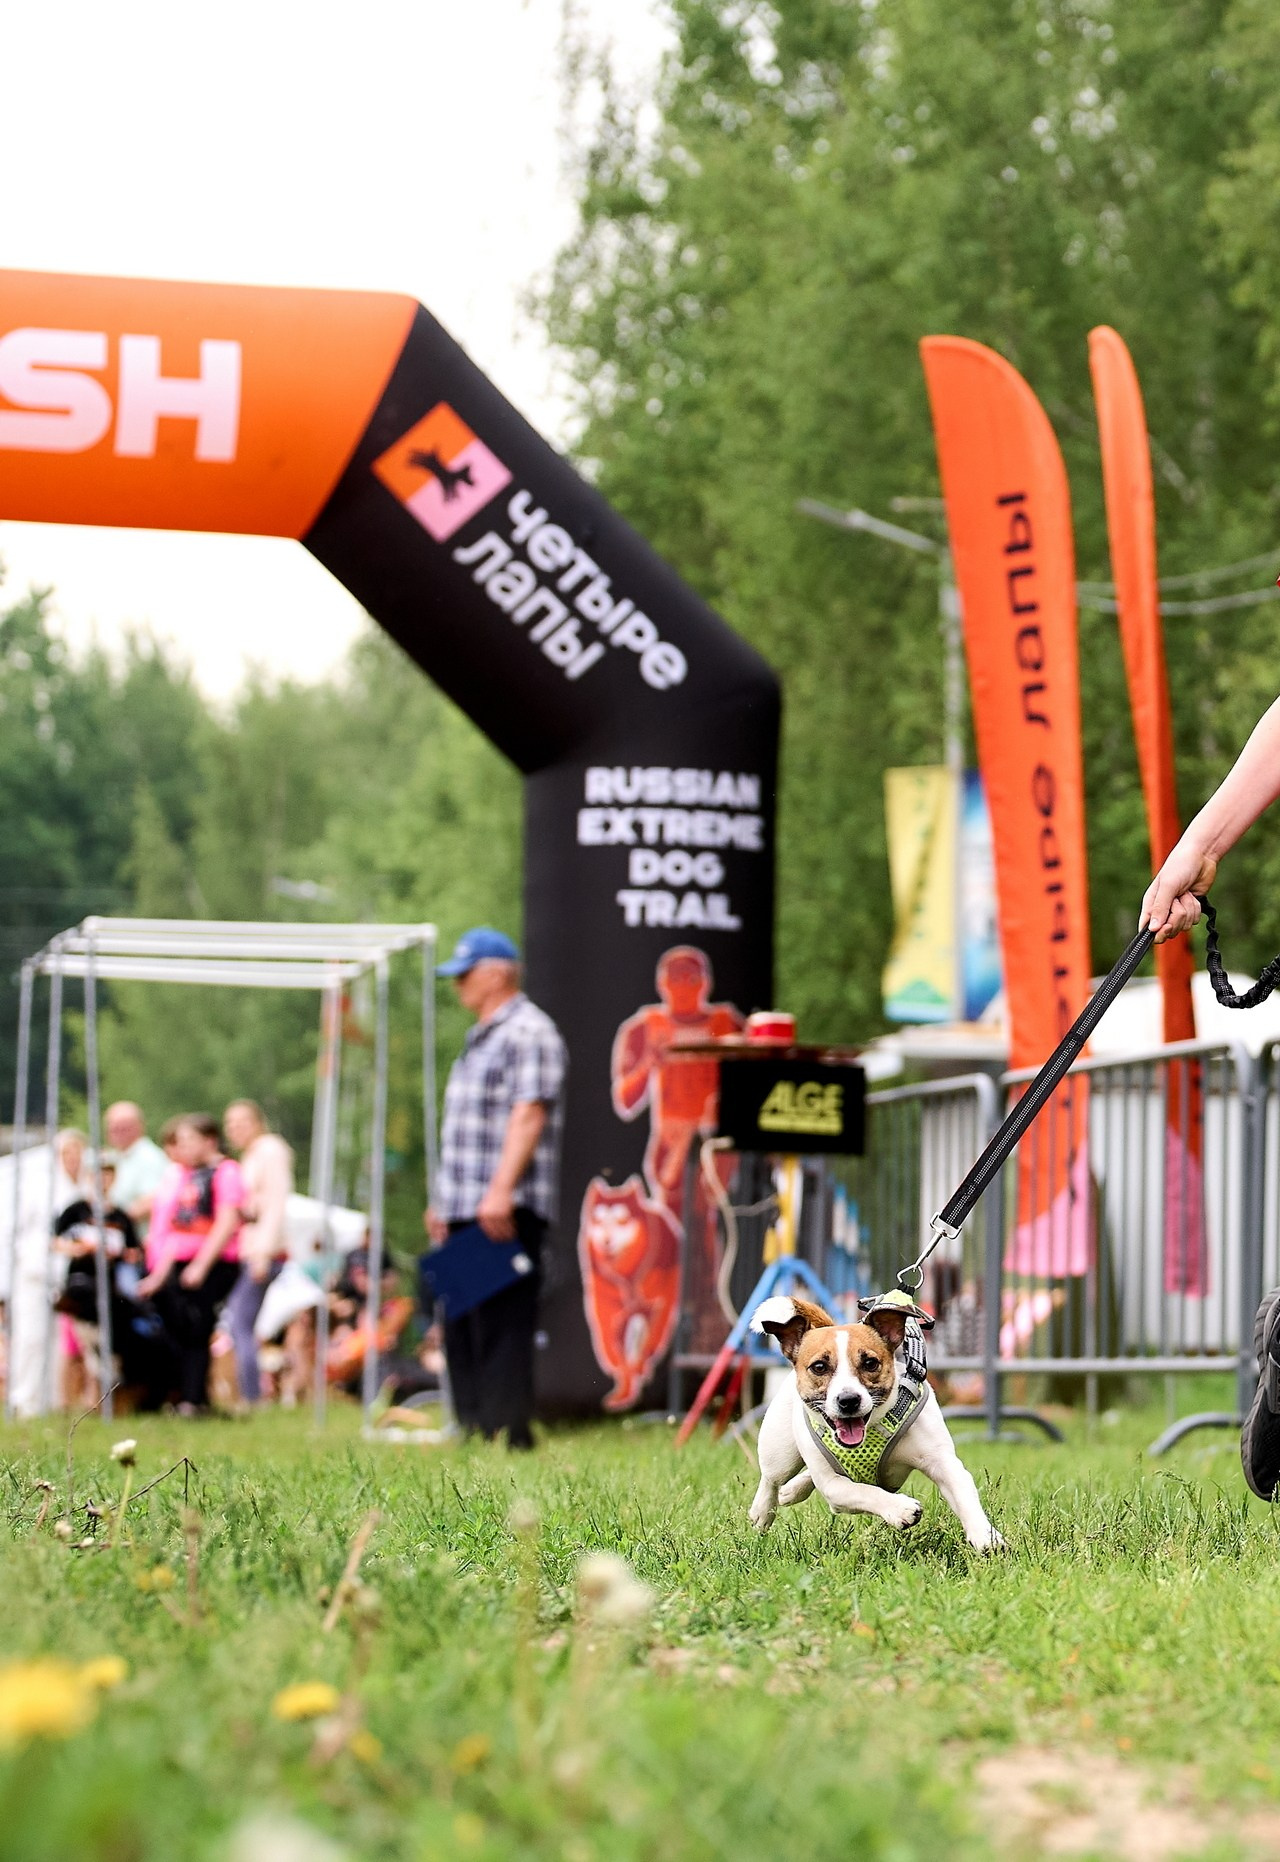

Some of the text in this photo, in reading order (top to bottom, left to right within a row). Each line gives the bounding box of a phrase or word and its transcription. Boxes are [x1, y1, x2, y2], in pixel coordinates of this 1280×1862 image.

[585, 766, 762, 809] RUSSIAN
[577, 807, 765, 852] EXTREME
[629, 848, 725, 888] DOG
[616, 889, 742, 931] TRAIL
